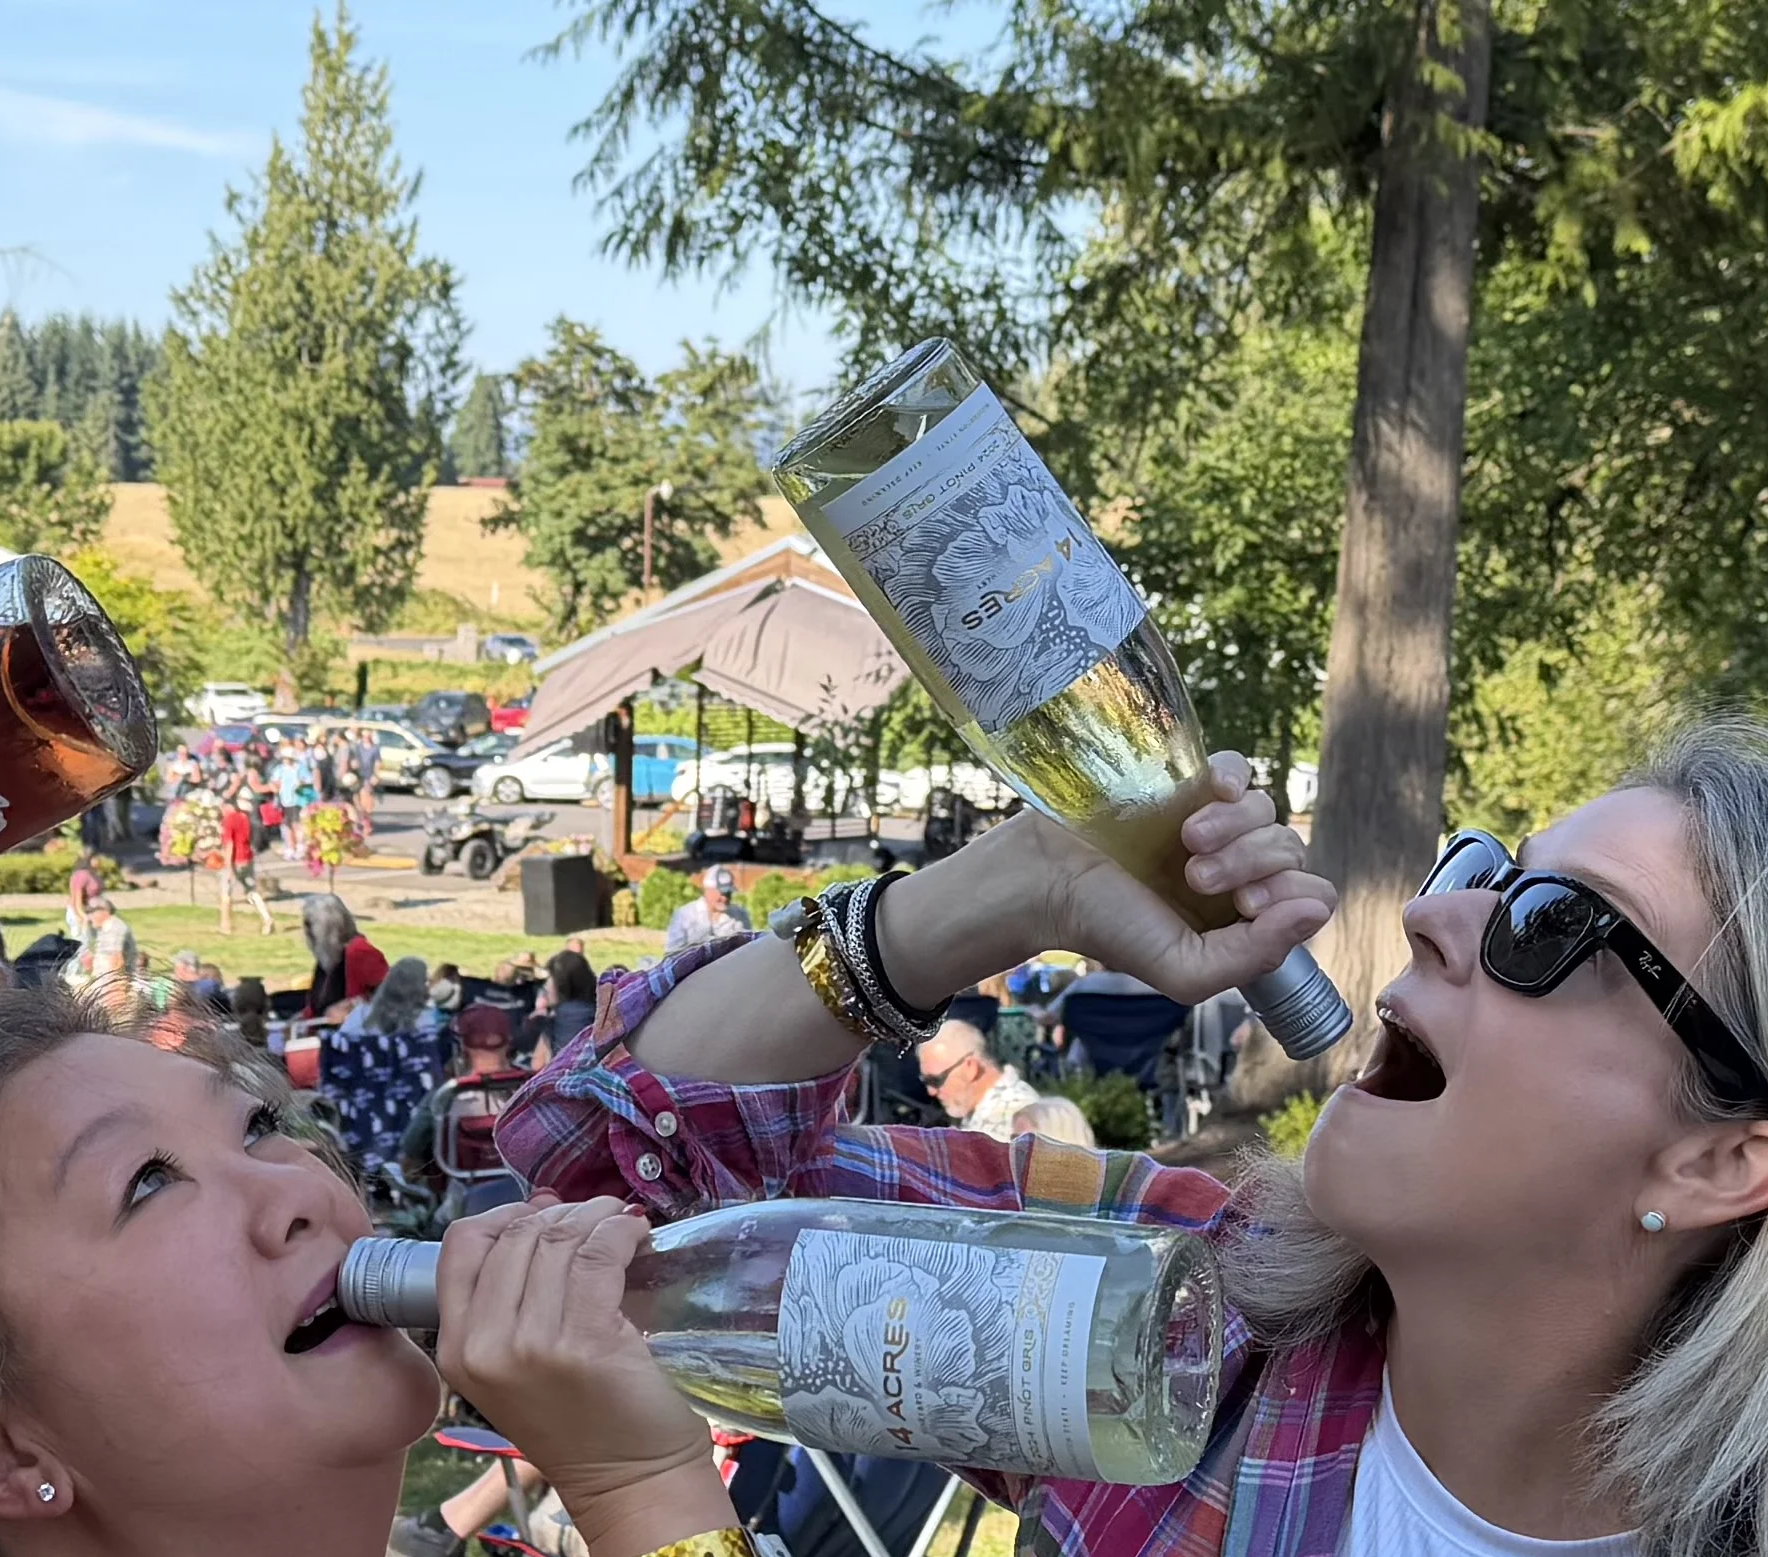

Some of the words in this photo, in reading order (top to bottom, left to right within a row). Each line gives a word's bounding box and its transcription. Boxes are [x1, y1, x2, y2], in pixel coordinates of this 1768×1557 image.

[936, 461, 976, 495] PINOT
[900, 492, 936, 521] GRIS
[881, 1296, 911, 1421] ACRES
[914, 1337, 922, 1376] WINERY
[1021, 1328, 1036, 1372] GRIS
[1016, 1375, 1037, 1426] PINOT
[885, 1428, 920, 1450] 14
